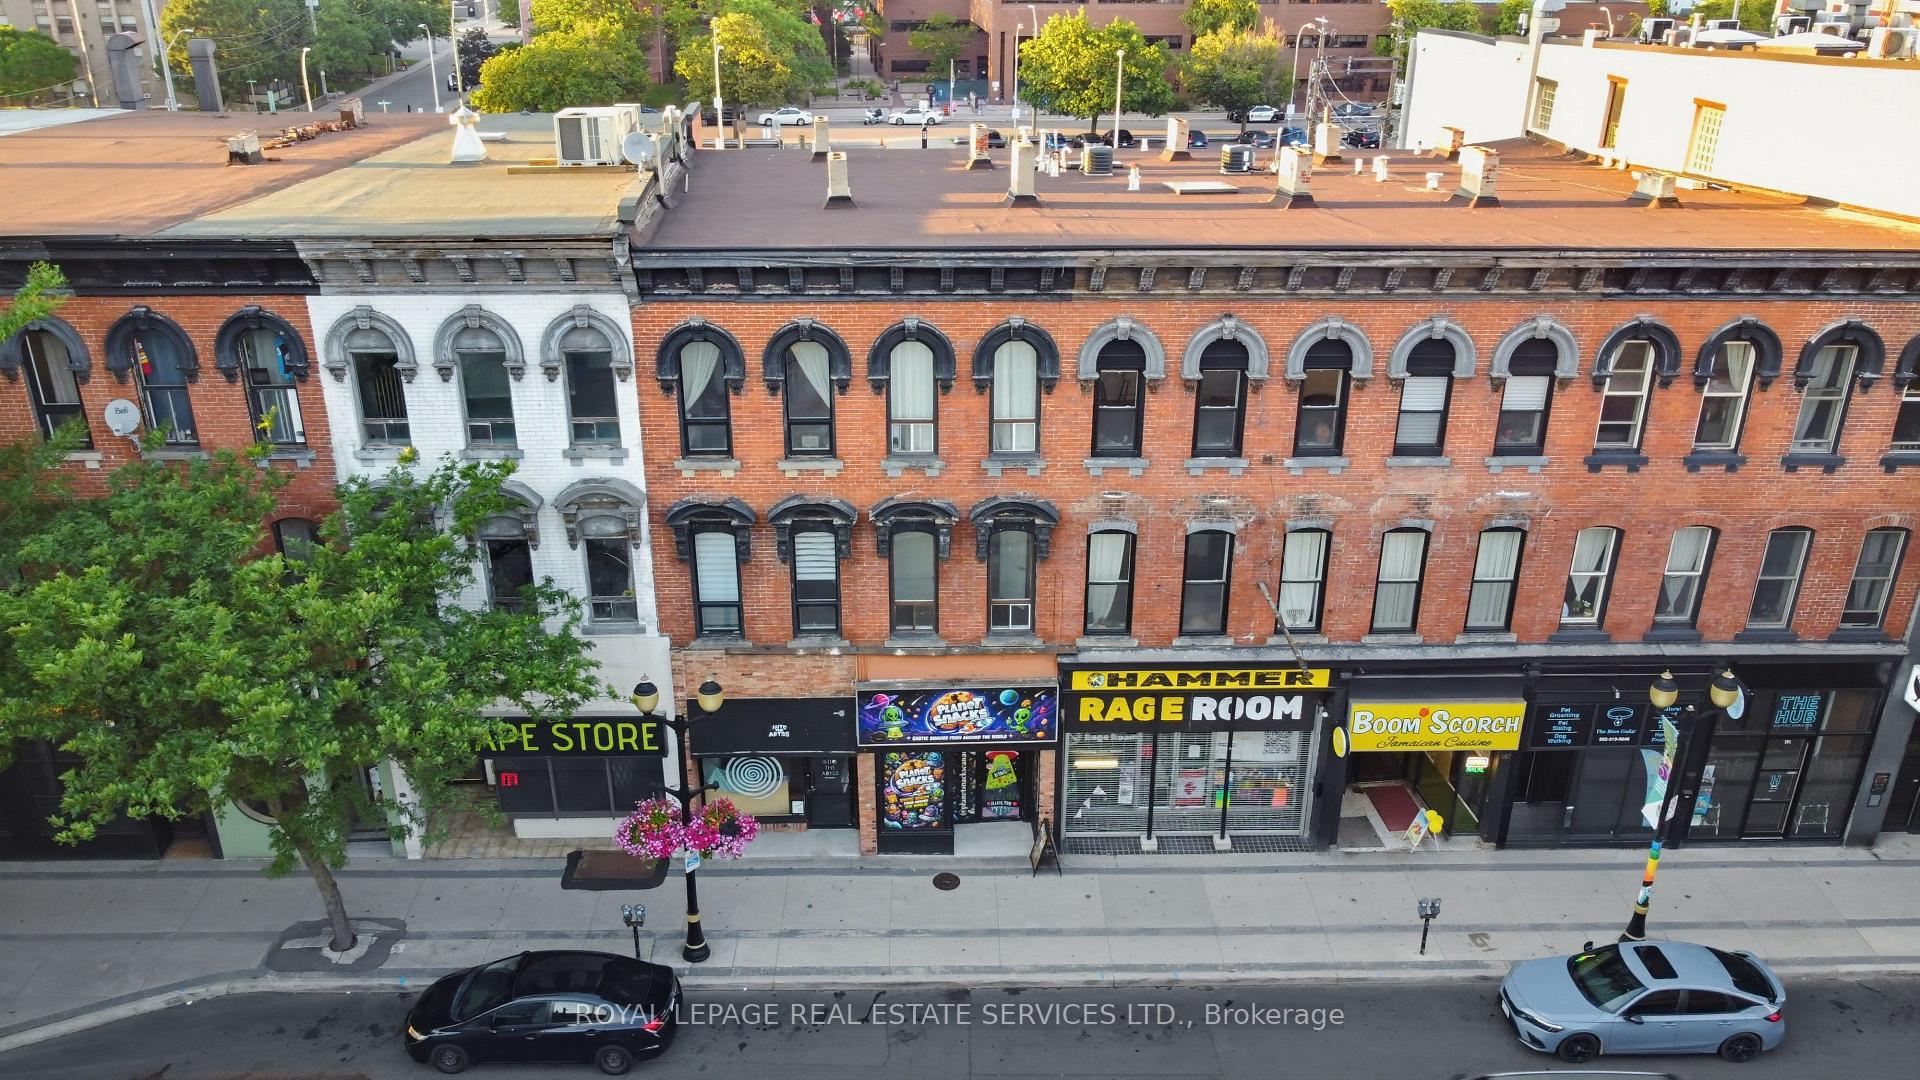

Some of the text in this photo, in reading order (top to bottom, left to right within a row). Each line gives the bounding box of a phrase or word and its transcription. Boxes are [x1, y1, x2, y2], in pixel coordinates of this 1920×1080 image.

[114, 406, 129, 415] Bell
[1107, 671, 1315, 687] HAMMER
[1080, 695, 1304, 722] RAGE ROOM
[1780, 695, 1821, 710] THE
[1774, 709, 1817, 724] HUB
[551, 722, 660, 752] STORE
[1376, 736, 1492, 748] Jamaican Cuisine
